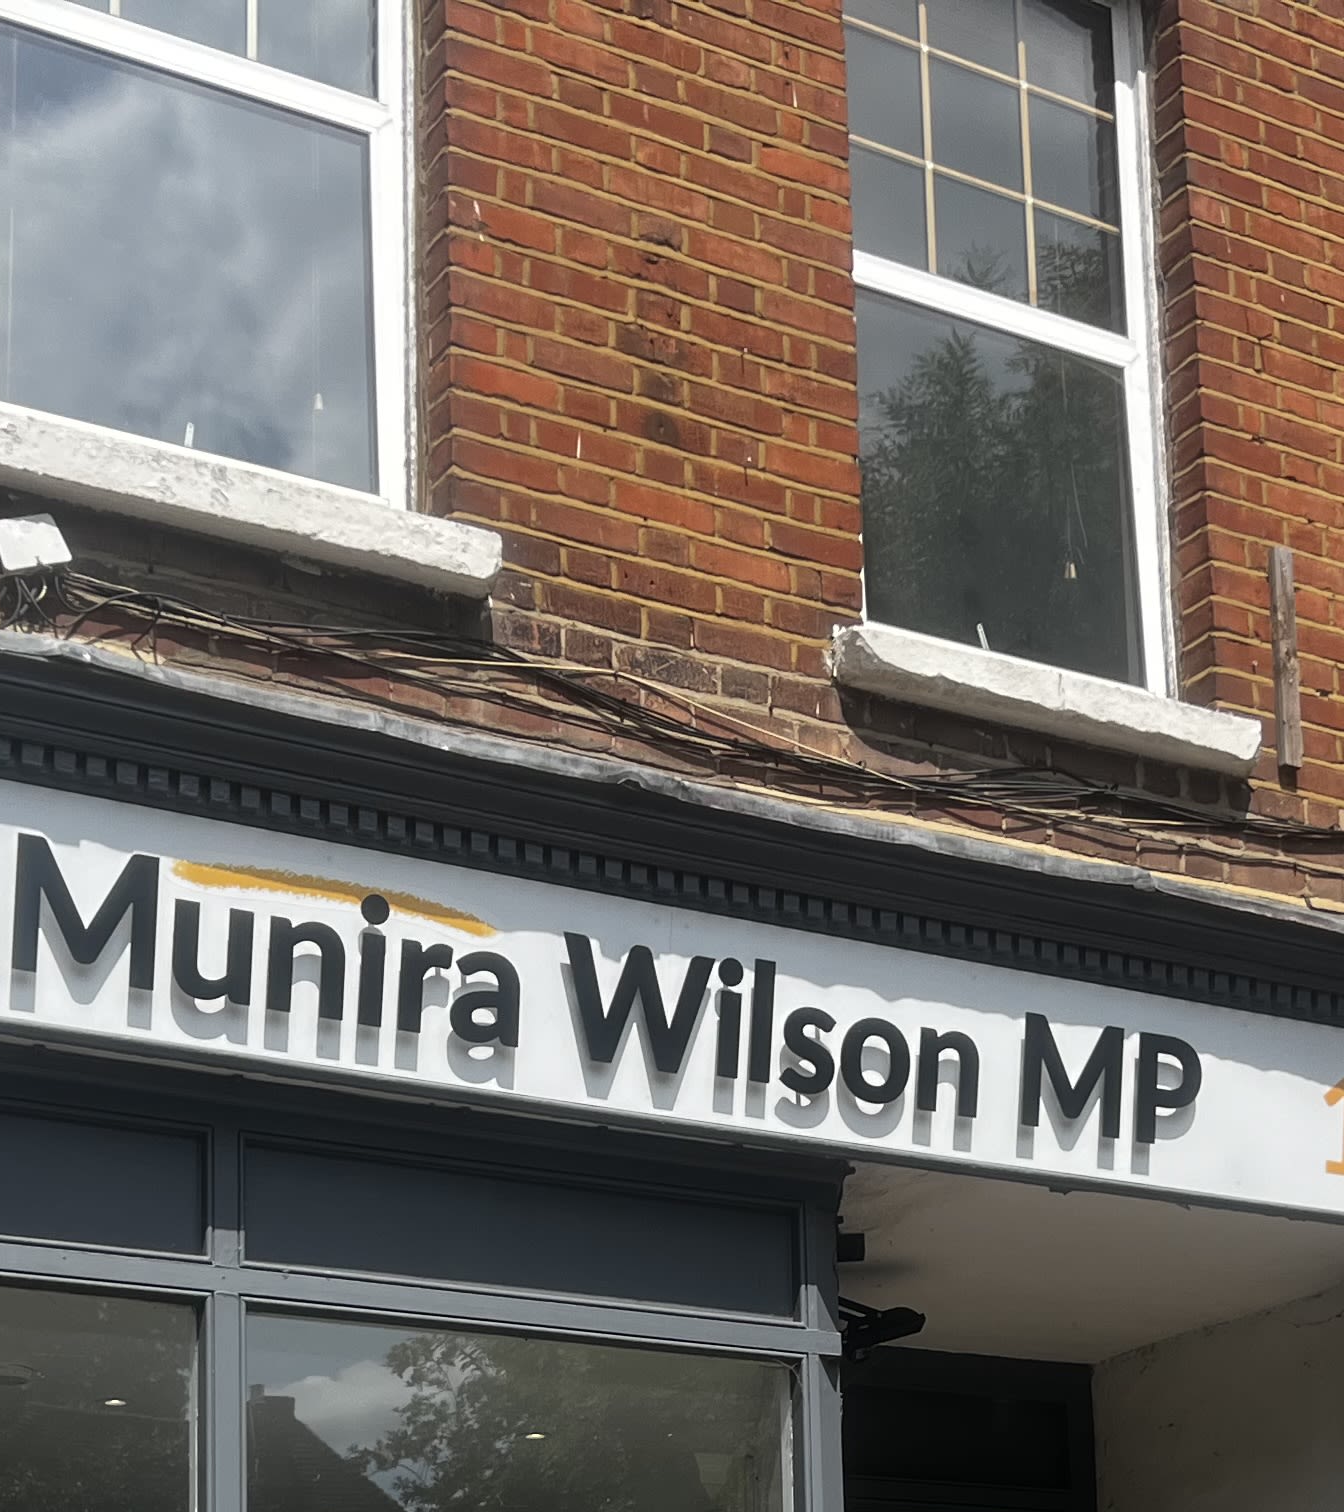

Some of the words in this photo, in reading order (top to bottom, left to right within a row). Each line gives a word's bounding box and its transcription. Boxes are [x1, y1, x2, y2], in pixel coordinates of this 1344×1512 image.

[11, 832, 521, 1048] Munira
[562, 931, 980, 1118] Wilson
[1021, 1011, 1203, 1145] MP
